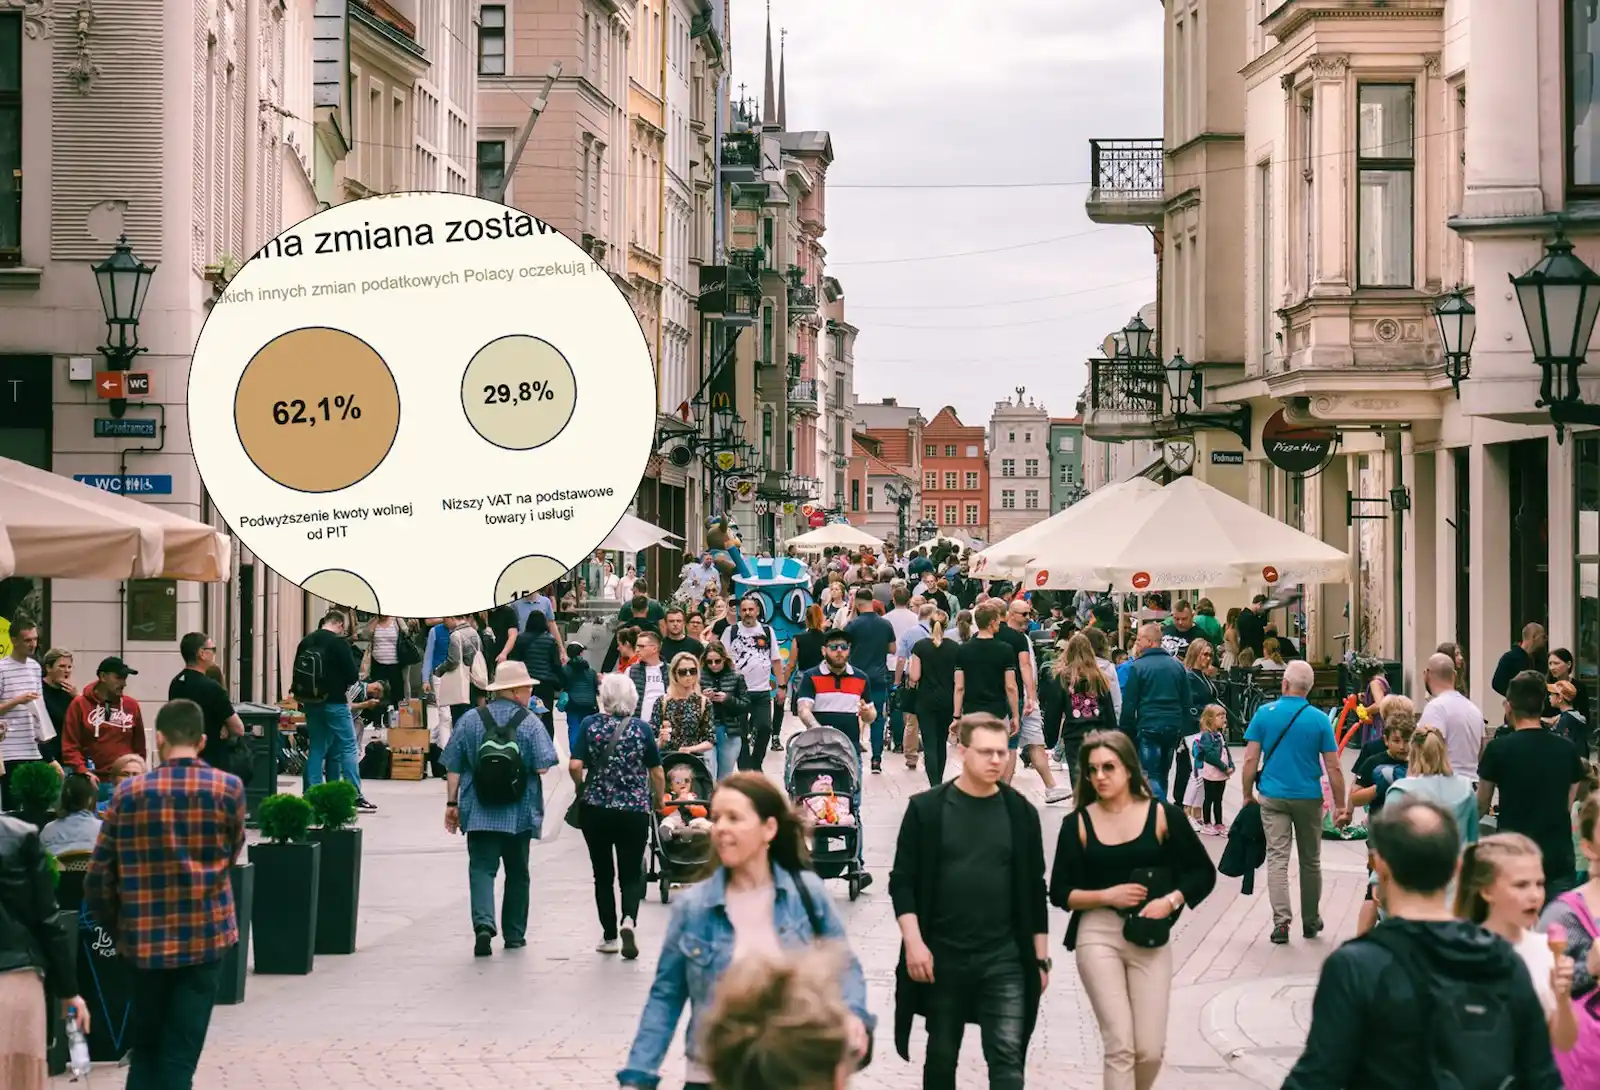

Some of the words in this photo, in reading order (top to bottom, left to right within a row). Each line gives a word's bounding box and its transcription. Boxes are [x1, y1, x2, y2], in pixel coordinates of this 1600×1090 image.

[129, 378, 148, 389] WC
[1273, 441, 1300, 452] Pizza
[1301, 444, 1323, 452] Hut
[95, 478, 121, 490] WC
